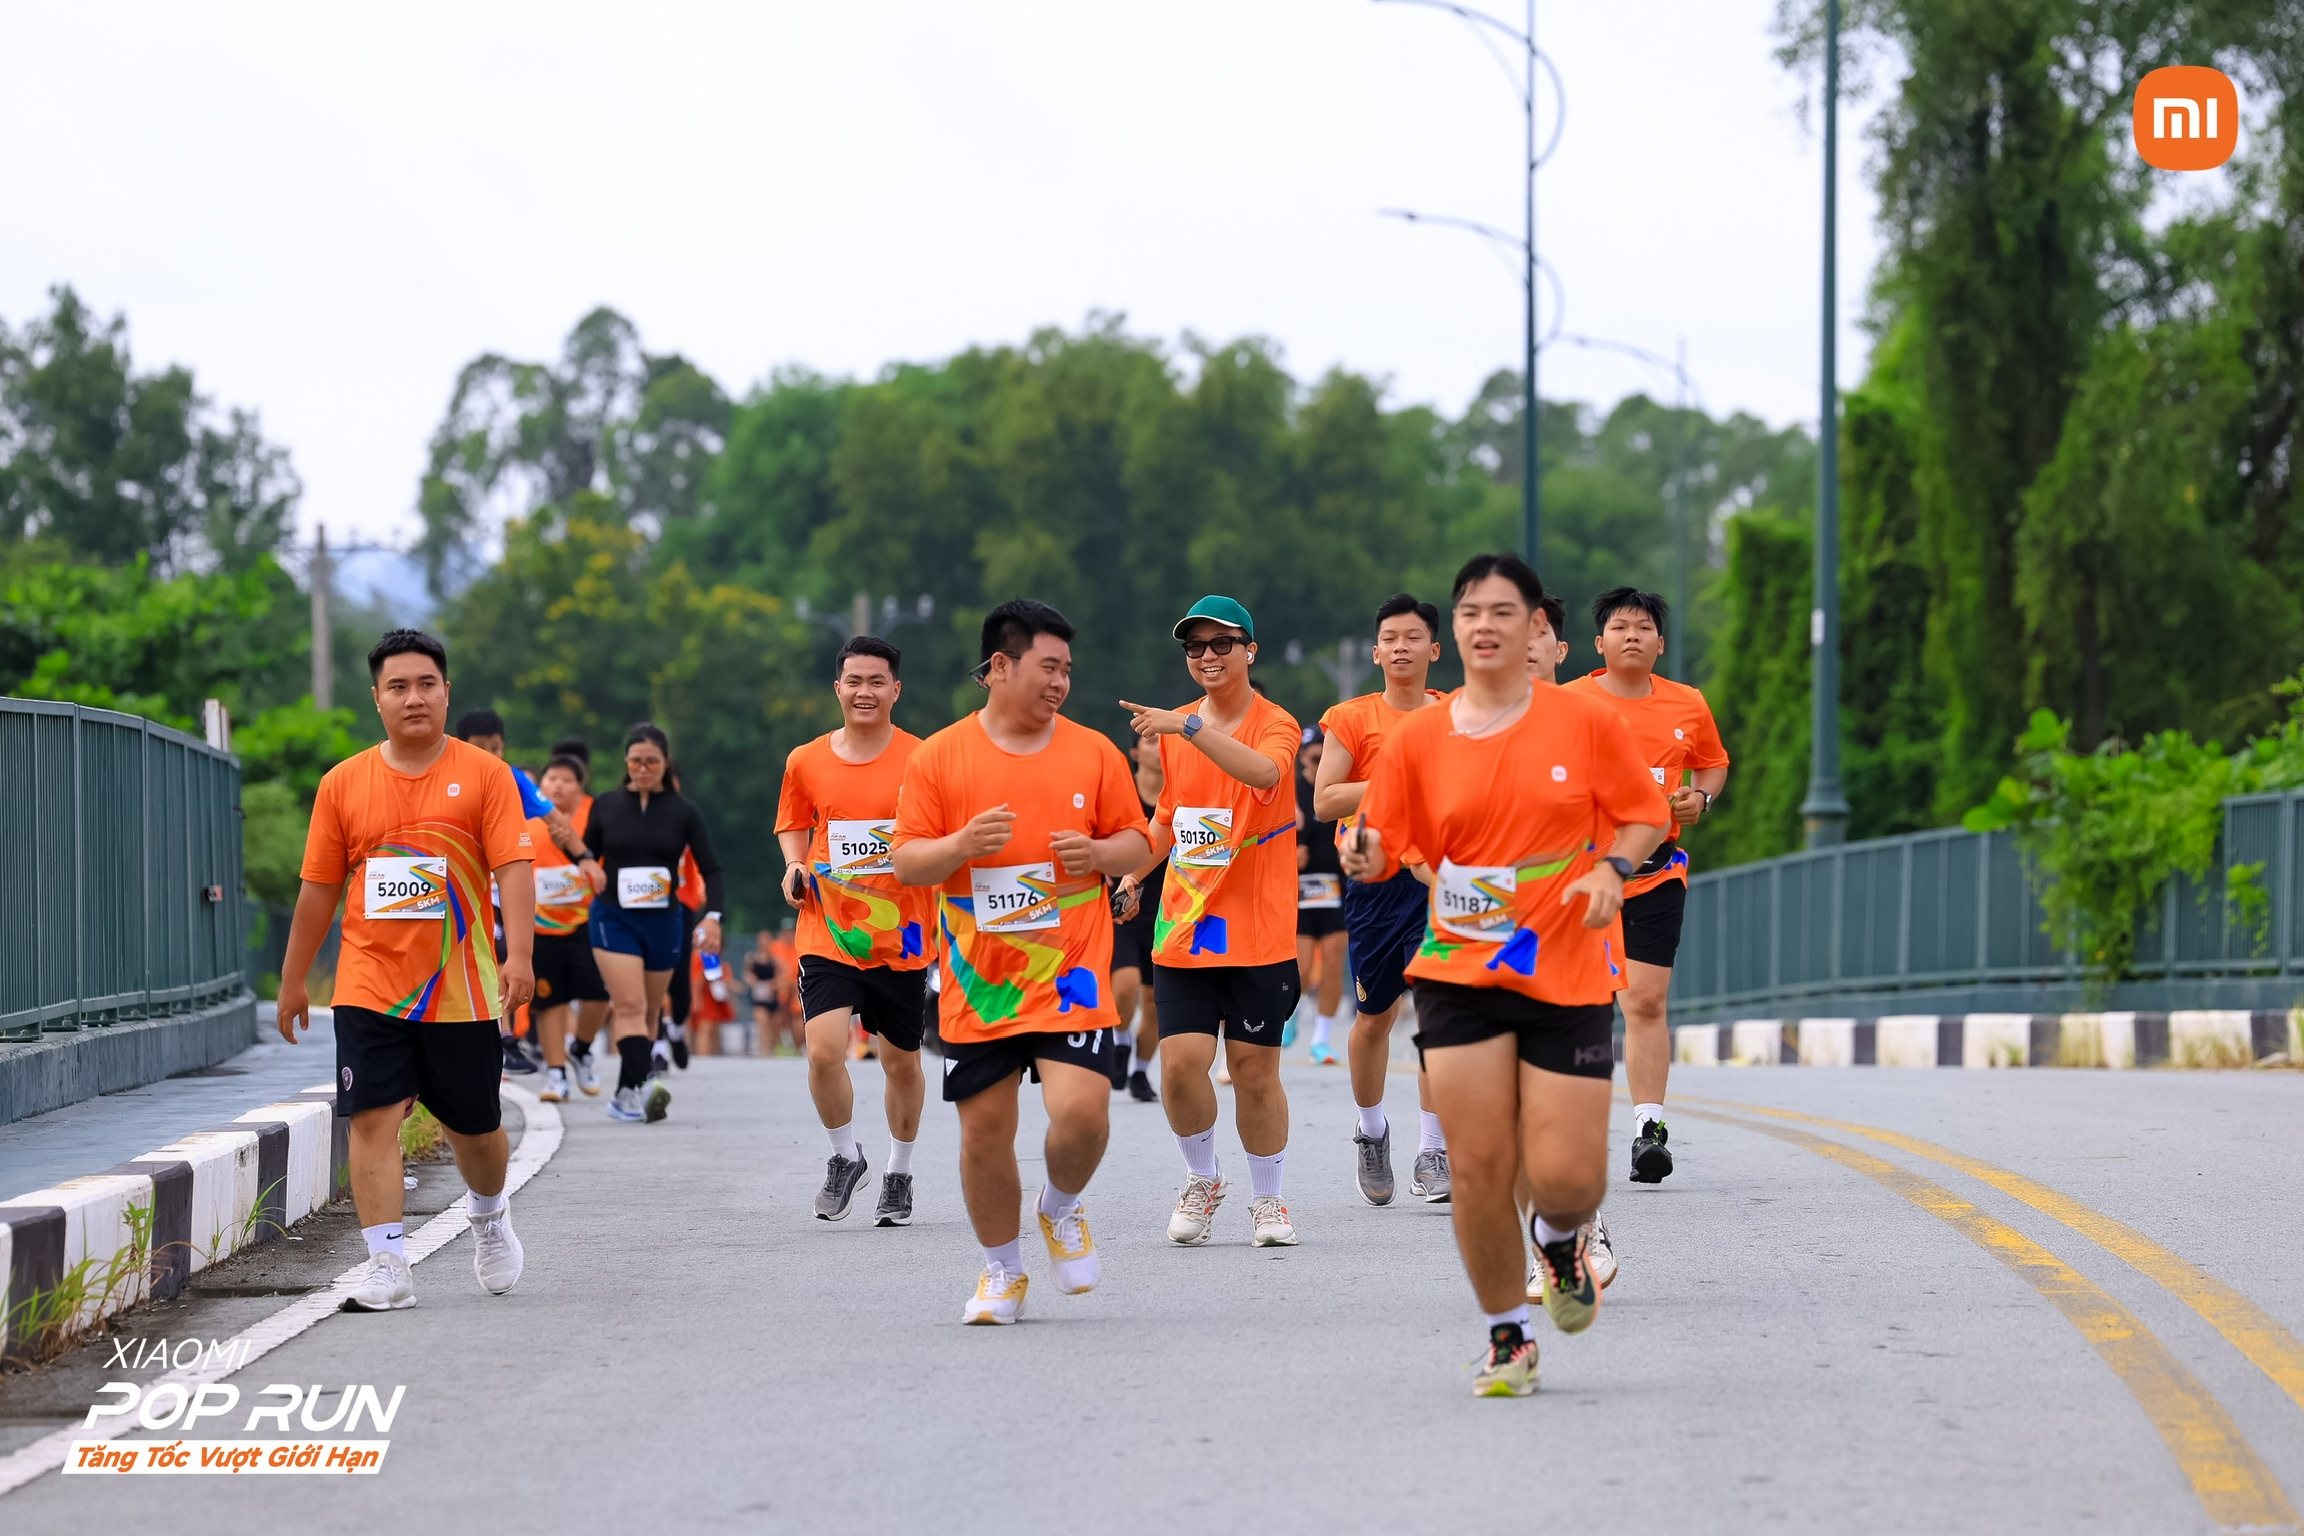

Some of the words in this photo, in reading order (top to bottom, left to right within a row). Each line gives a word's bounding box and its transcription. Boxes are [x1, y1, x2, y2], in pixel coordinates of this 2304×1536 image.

[1180, 830, 1216, 845] 50130
[842, 842, 888, 856] 51025
[1205, 844, 1225, 857] 5KM
[877, 856, 892, 866] 5K
[378, 881, 431, 897] 52009
[417, 896, 440, 909] 5KM
[988, 890, 1038, 909] 51176
[1444, 890, 1493, 914] 51187
[1029, 904, 1052, 920] 5KM
